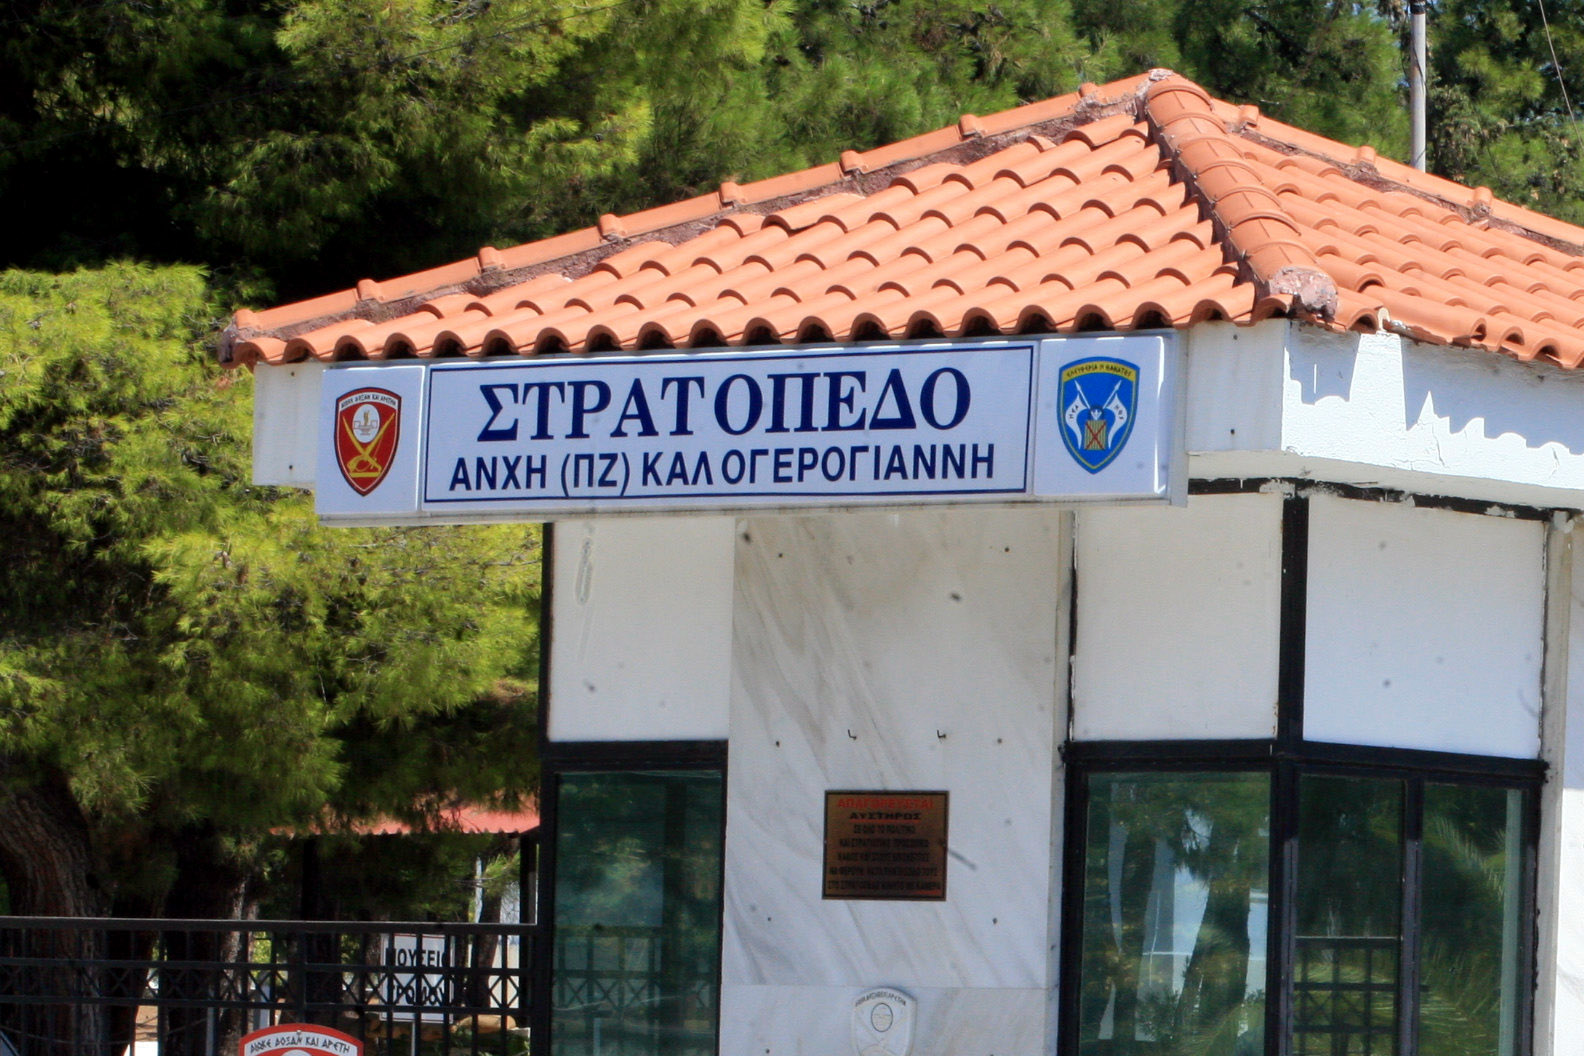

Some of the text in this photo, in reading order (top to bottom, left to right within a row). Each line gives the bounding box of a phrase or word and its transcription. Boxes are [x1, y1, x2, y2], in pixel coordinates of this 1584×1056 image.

[477, 367, 971, 442] ΣΤΡΑΤΟΠΕΔΟ
[449, 443, 995, 497] ΑΝΧΗ (ΠΖ) ΚΑΛΟΓΕΡΟΓΙΑΝΝΗ
[305, 1036, 319, 1047] ΚΑΙ
